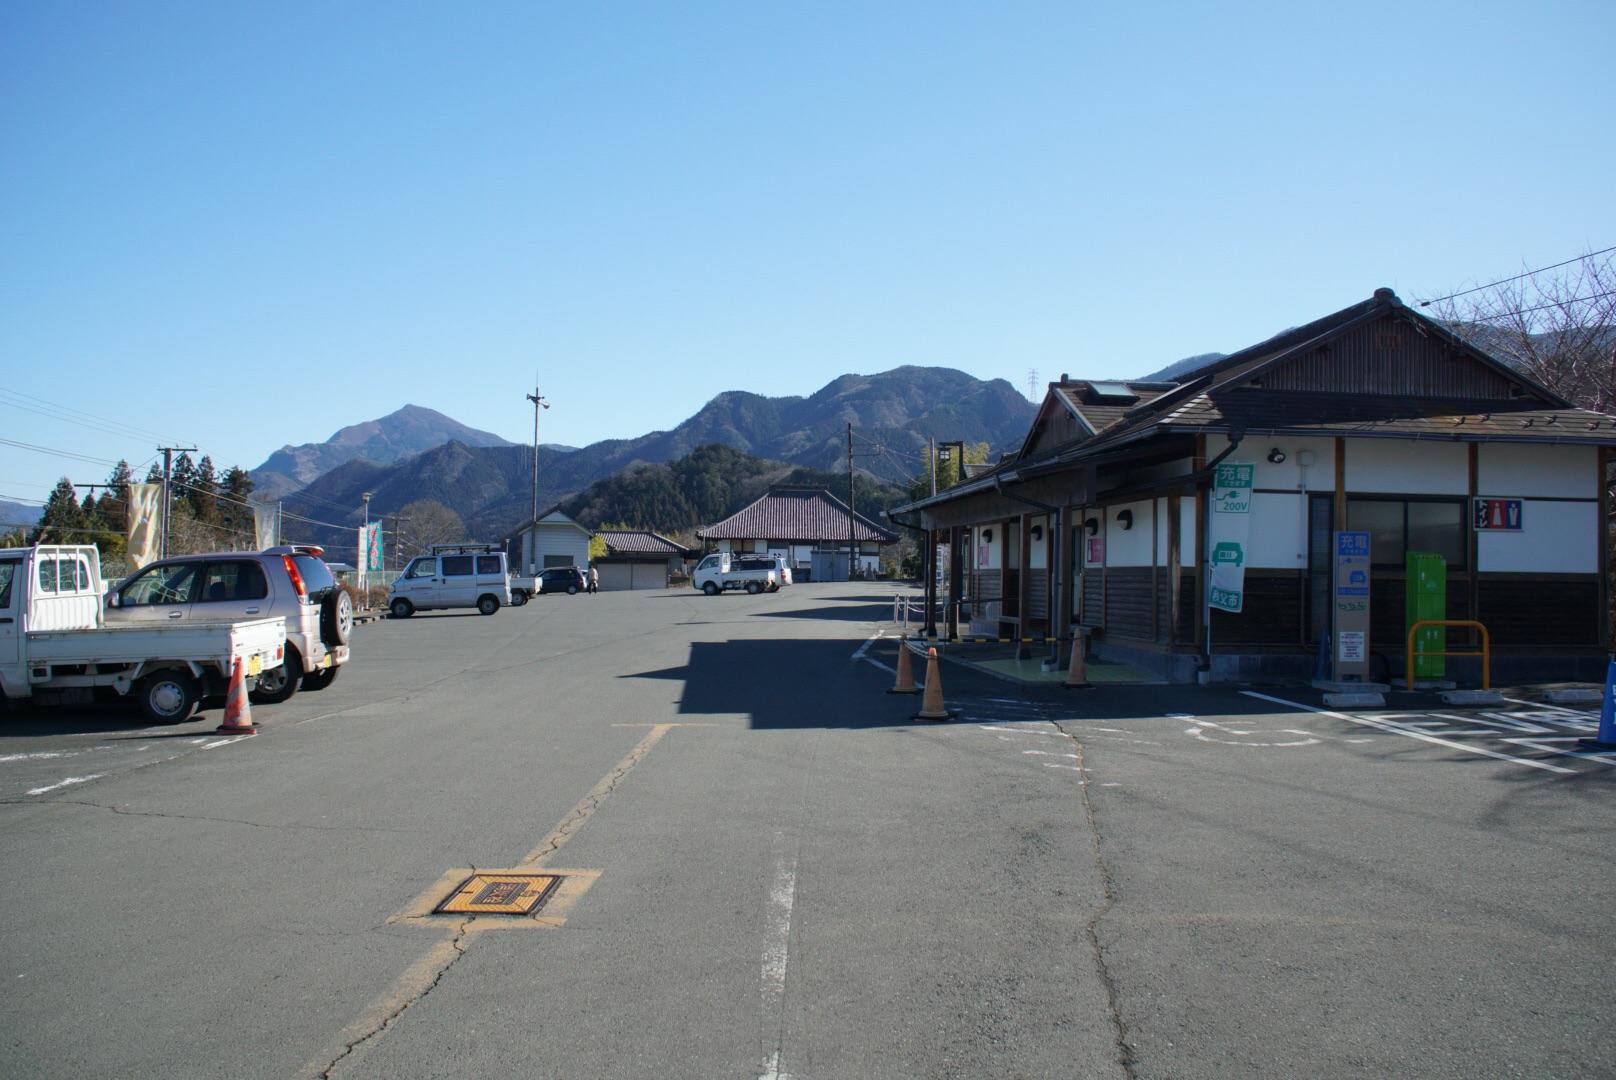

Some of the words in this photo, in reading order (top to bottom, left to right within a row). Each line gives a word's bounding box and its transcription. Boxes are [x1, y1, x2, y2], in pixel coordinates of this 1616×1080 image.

[1220, 467, 1250, 480] 充電
[1223, 502, 1248, 511] 200V
[1479, 500, 1488, 528] トイレ
